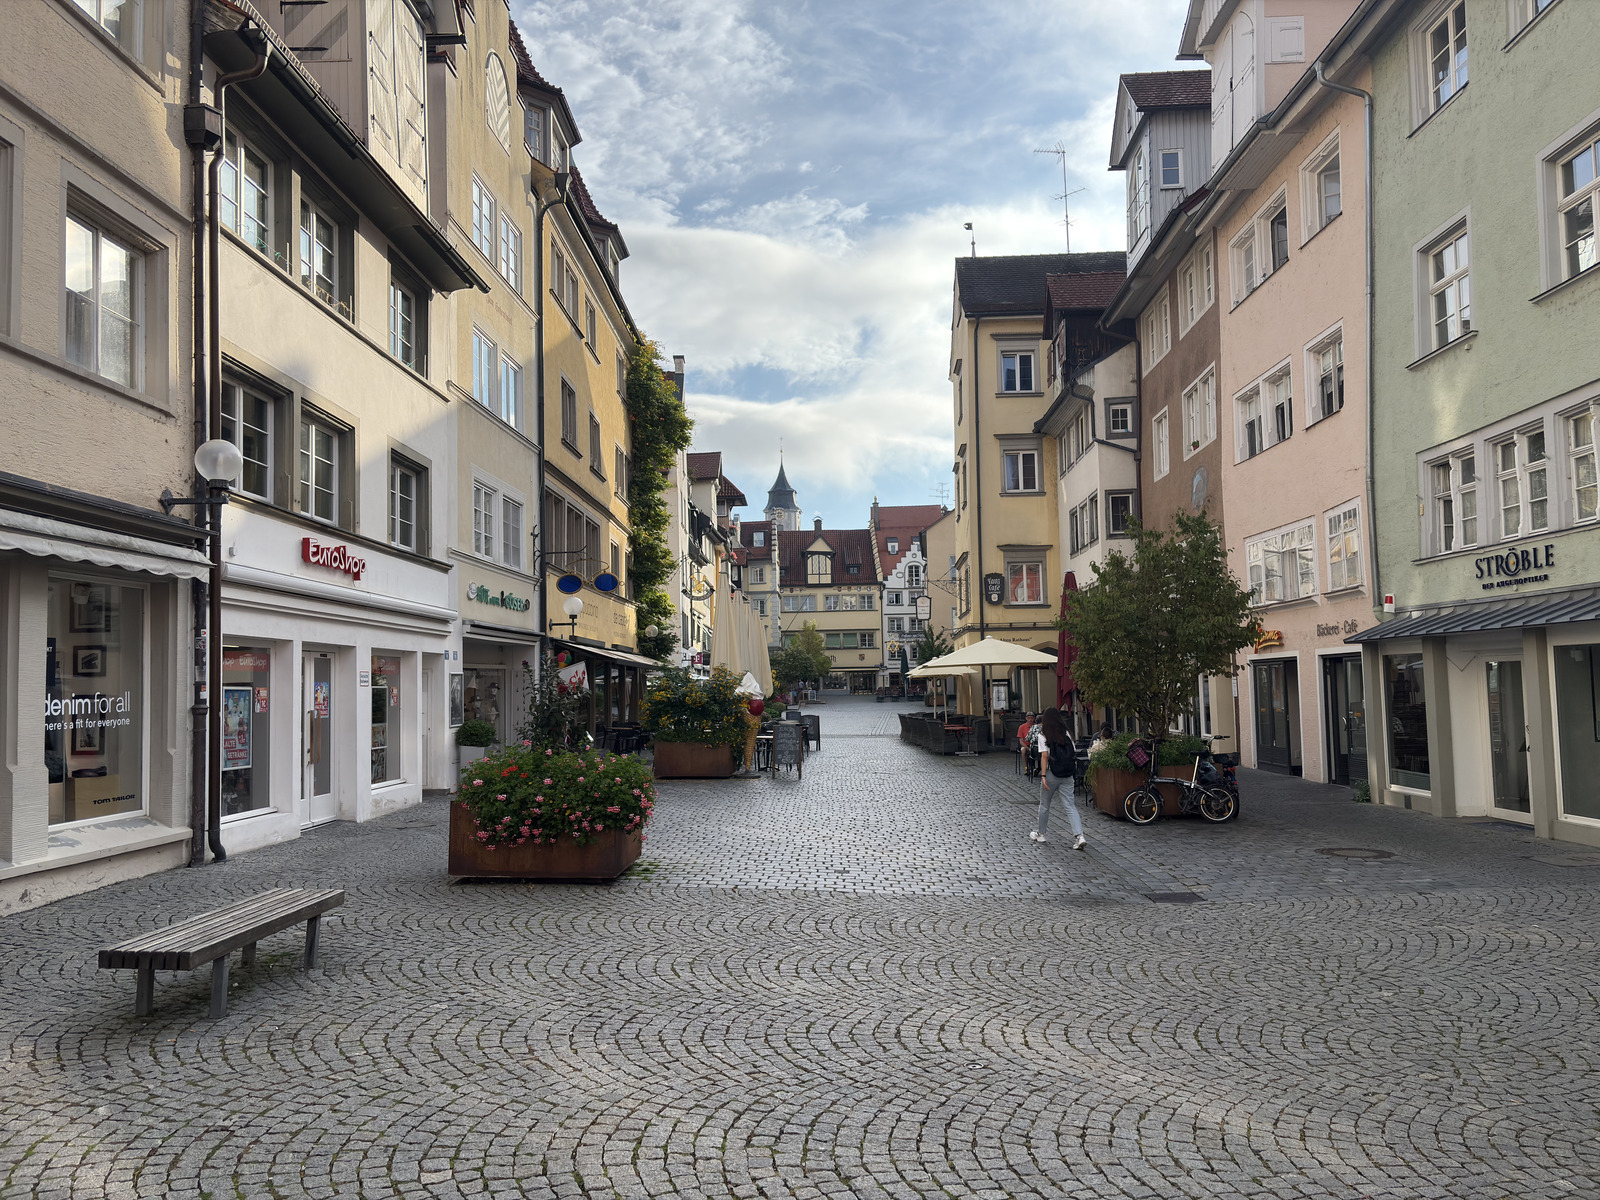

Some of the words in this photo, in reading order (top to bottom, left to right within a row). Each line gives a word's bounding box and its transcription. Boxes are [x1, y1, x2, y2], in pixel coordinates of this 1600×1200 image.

[1475, 544, 1555, 579] STRÖBLE
[44, 692, 91, 716] denim
[94, 691, 115, 714] for
[115, 691, 131, 713] all
[69, 722, 74, 730] a
[75, 718, 84, 729] fit
[85, 718, 97, 728] for
[97, 716, 131, 729] everyone
[111, 793, 136, 802] TAILOR
